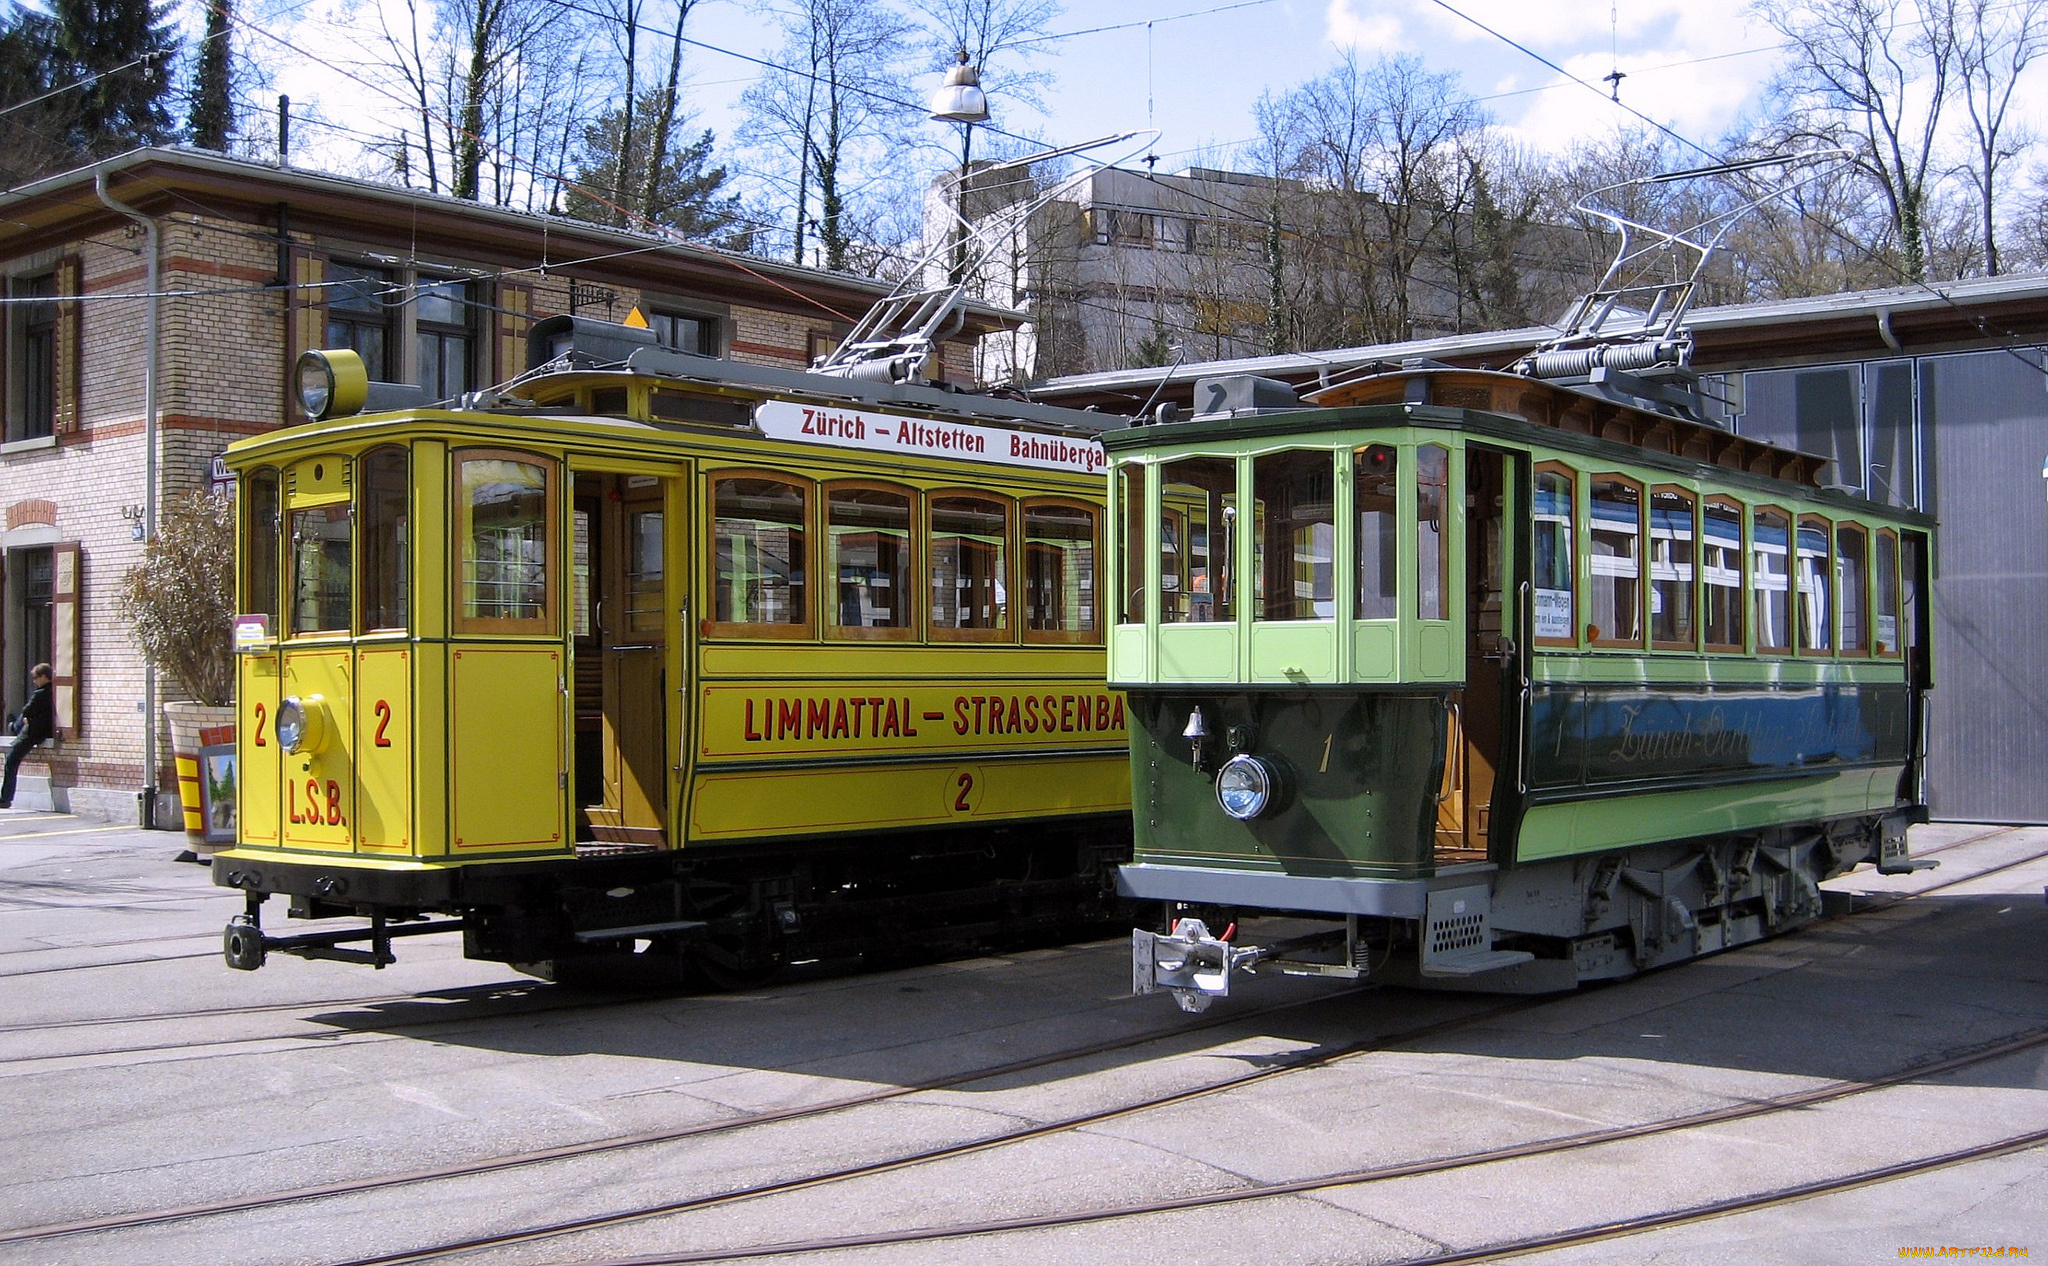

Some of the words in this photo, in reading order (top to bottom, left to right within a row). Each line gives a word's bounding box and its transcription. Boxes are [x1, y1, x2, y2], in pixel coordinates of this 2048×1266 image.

[801, 408, 865, 440] Zürich
[896, 420, 985, 453] Altstetten
[254, 702, 266, 747] 2
[374, 699, 391, 747] 2
[744, 697, 917, 742] LIMMATTAL
[1319, 733, 1333, 773] 1
[289, 778, 347, 826] L.S.B.
[955, 772, 973, 811] 2
